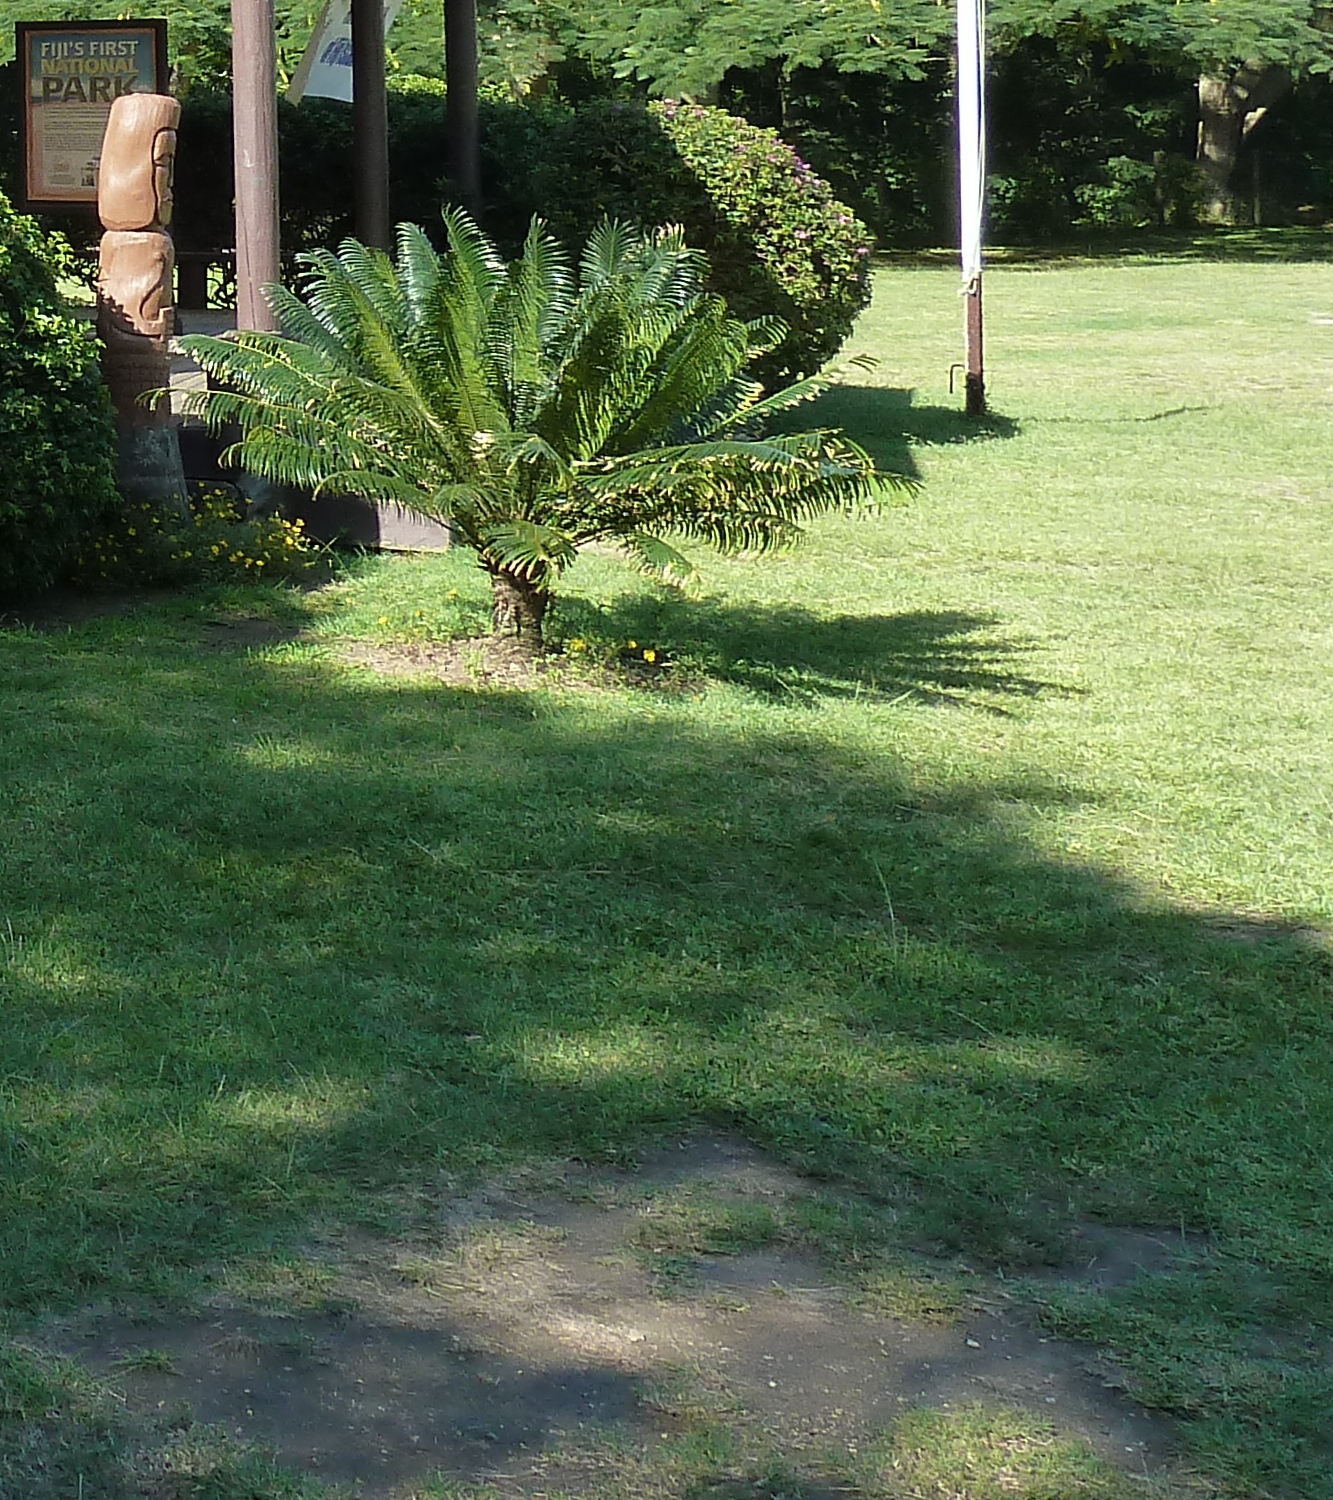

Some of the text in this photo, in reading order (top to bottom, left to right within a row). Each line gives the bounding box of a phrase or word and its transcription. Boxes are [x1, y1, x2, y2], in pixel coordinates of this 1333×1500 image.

[41, 40, 138, 59] FIJI'S FIRST
[41, 58, 139, 74] NATIONAL
[42, 75, 138, 102] PARK
